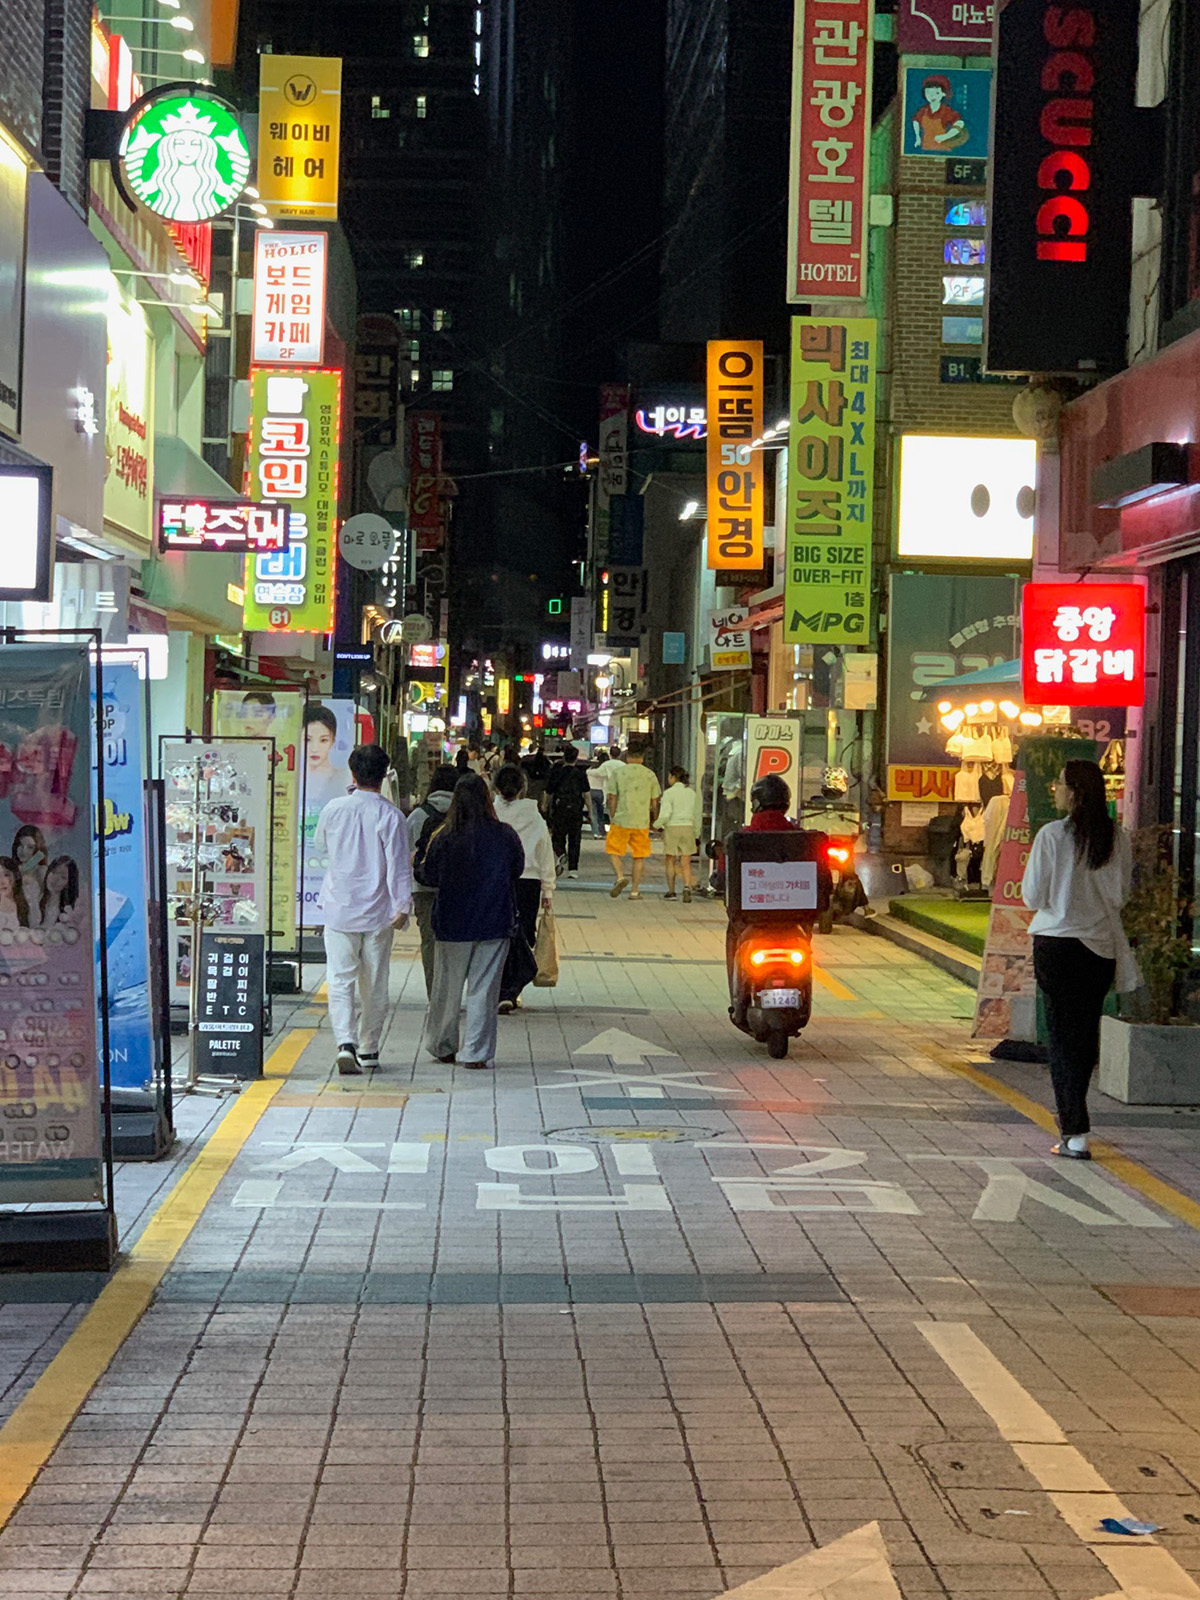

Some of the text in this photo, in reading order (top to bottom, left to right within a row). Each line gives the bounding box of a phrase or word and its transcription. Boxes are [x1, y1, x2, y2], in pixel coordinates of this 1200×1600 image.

[270, 122, 330, 142] 웨이비
[808, 0, 864, 245] 관광호텔
[273, 156, 324, 179] 헤어
[264, 244, 317, 258] HOLIC
[266, 265, 311, 286] 보드
[800, 264, 857, 282] HOTEL
[266, 293, 311, 315] 게임
[264, 321, 310, 343] 카페
[280, 348, 295, 358] 2F
[795, 325, 848, 538] 빅사이즈
[794, 546, 864, 564] BIG SIZE
[793, 569, 863, 584] OVER-FIT
[256, 584, 304, 603] 연습장
[844, 592, 864, 607] 1층
[271, 610, 289, 624] B1
[790, 609, 864, 633] MPG
[1053, 607, 1116, 641] 중앙
[715, 634, 746, 648] 아트
[1034, 649, 1134, 683] 닭갈비
[755, 725, 793, 741] 아이스
[895, 769, 956, 799] 빅사
[209, 1040, 241, 1050] PALETTE
